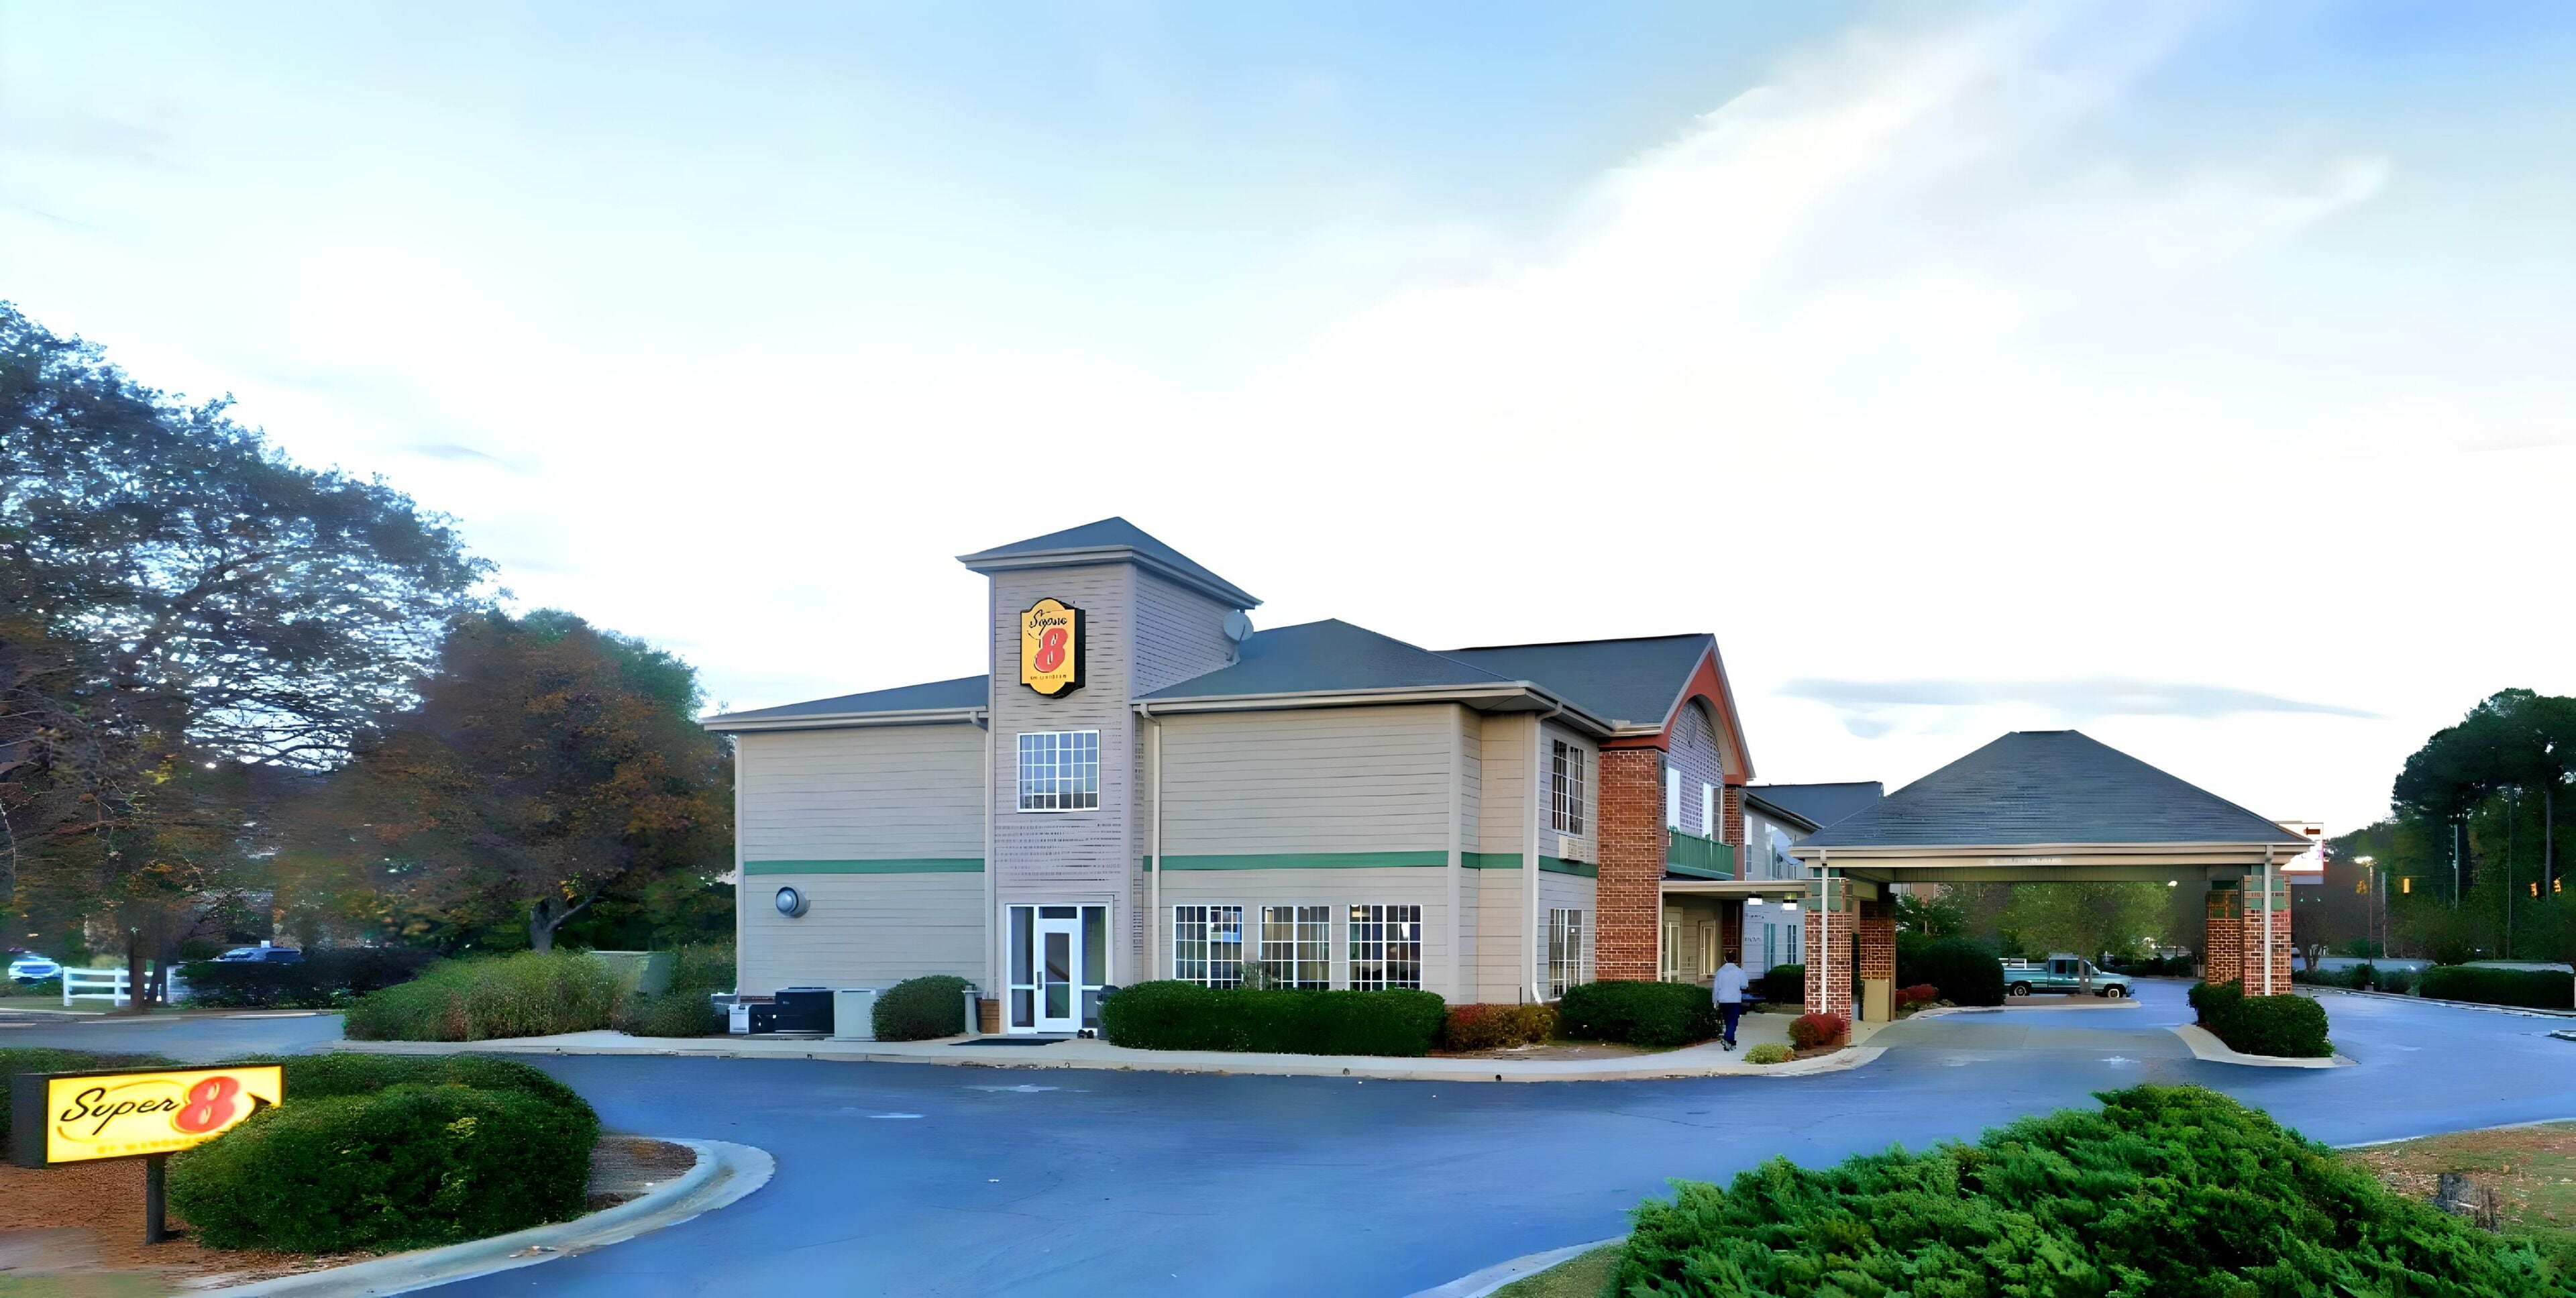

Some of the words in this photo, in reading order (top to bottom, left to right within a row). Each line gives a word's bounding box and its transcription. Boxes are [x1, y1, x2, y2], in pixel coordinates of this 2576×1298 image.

[1034, 628, 1068, 673] 8
[60, 1087, 180, 1135] Super
[174, 1076, 239, 1132] 8
